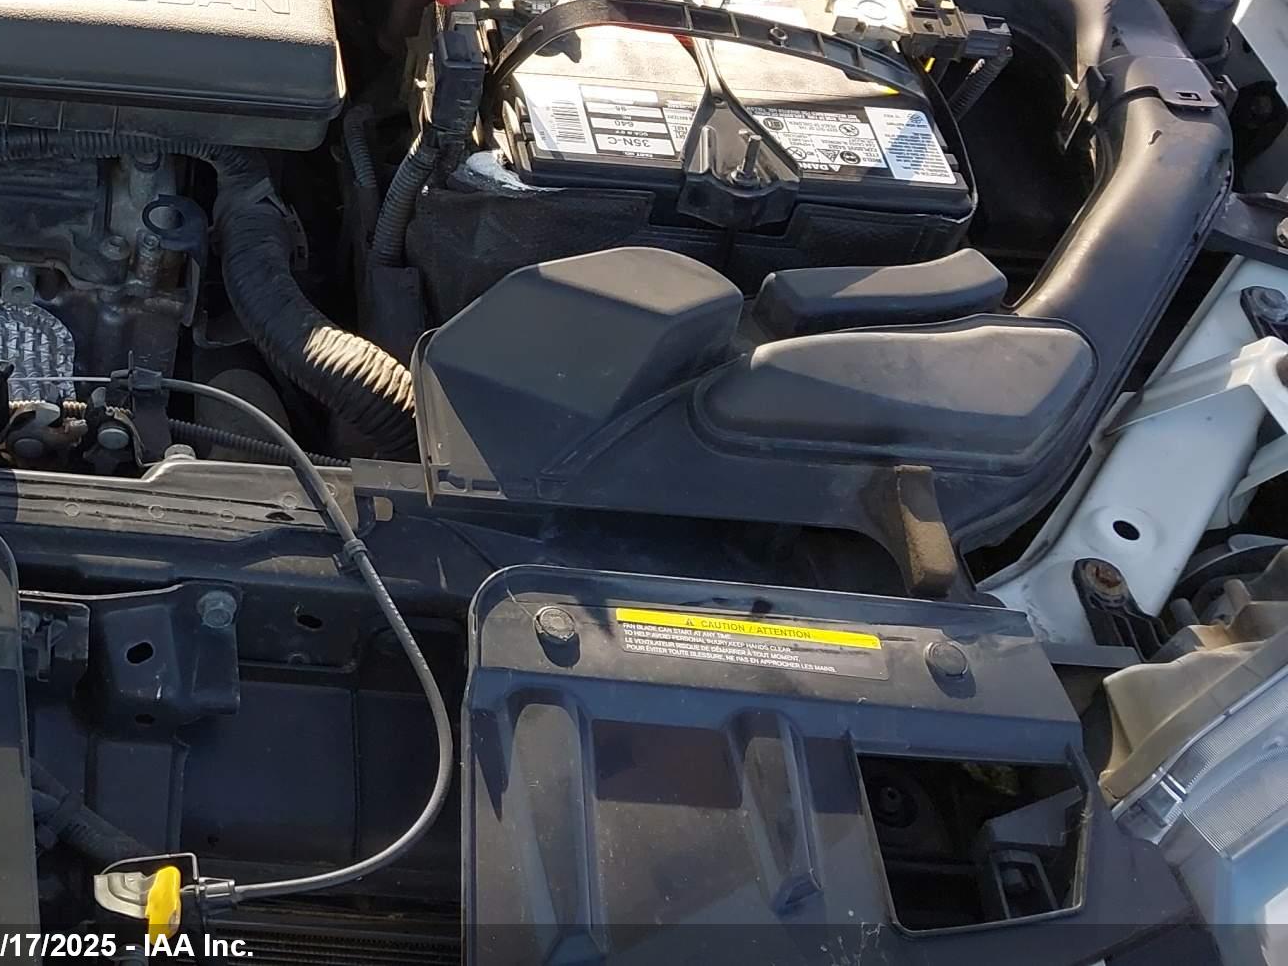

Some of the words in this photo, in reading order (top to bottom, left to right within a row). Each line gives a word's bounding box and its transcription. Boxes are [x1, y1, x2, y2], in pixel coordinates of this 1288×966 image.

[607, 135, 651, 148] 35N-C
[700, 619, 745, 633] CAUTION
[757, 625, 811, 639] ATTENTION
